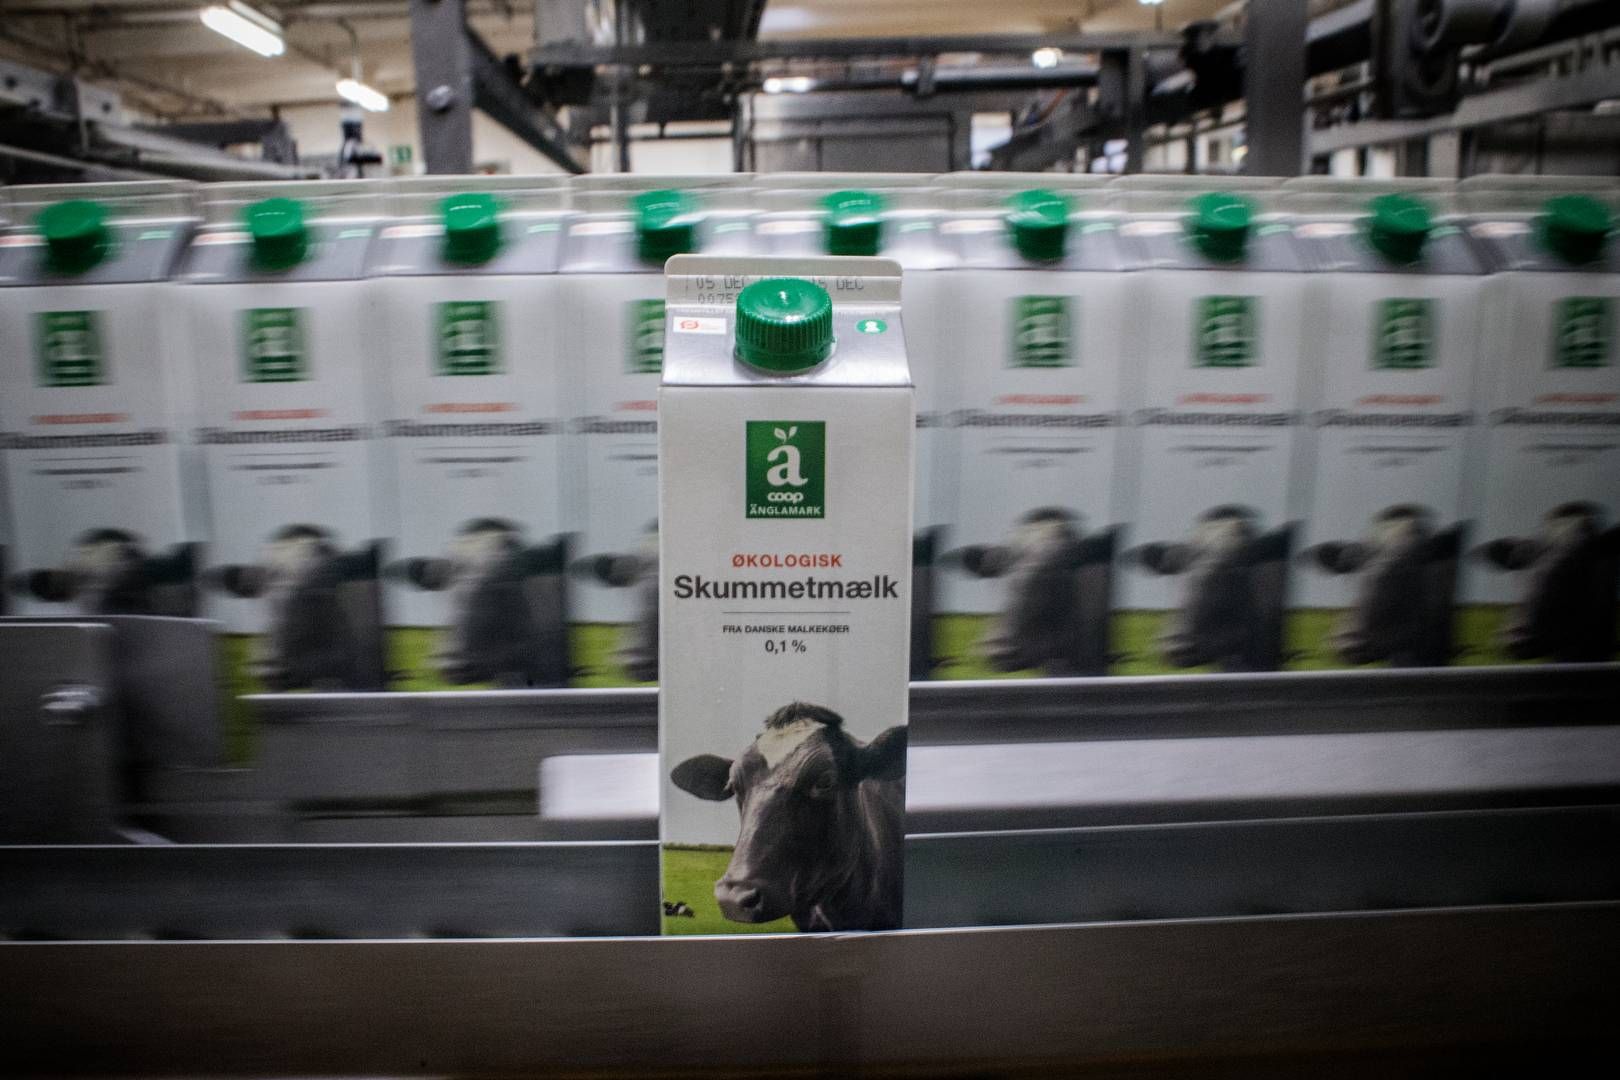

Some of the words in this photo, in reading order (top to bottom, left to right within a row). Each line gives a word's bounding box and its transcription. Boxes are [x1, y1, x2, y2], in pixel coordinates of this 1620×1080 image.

[767, 491, 804, 504] coop
[749, 504, 821, 515] ÄNGLAMARK
[732, 553, 843, 568] ØKOLOGISK
[673, 575, 899, 599] Skummetmælk
[722, 624, 742, 633] FRA
[744, 624, 785, 633] DANSKE
[787, 624, 850, 633] MALKEKØER
[765, 639, 786, 654] 0,1
[791, 639, 807, 653] %
